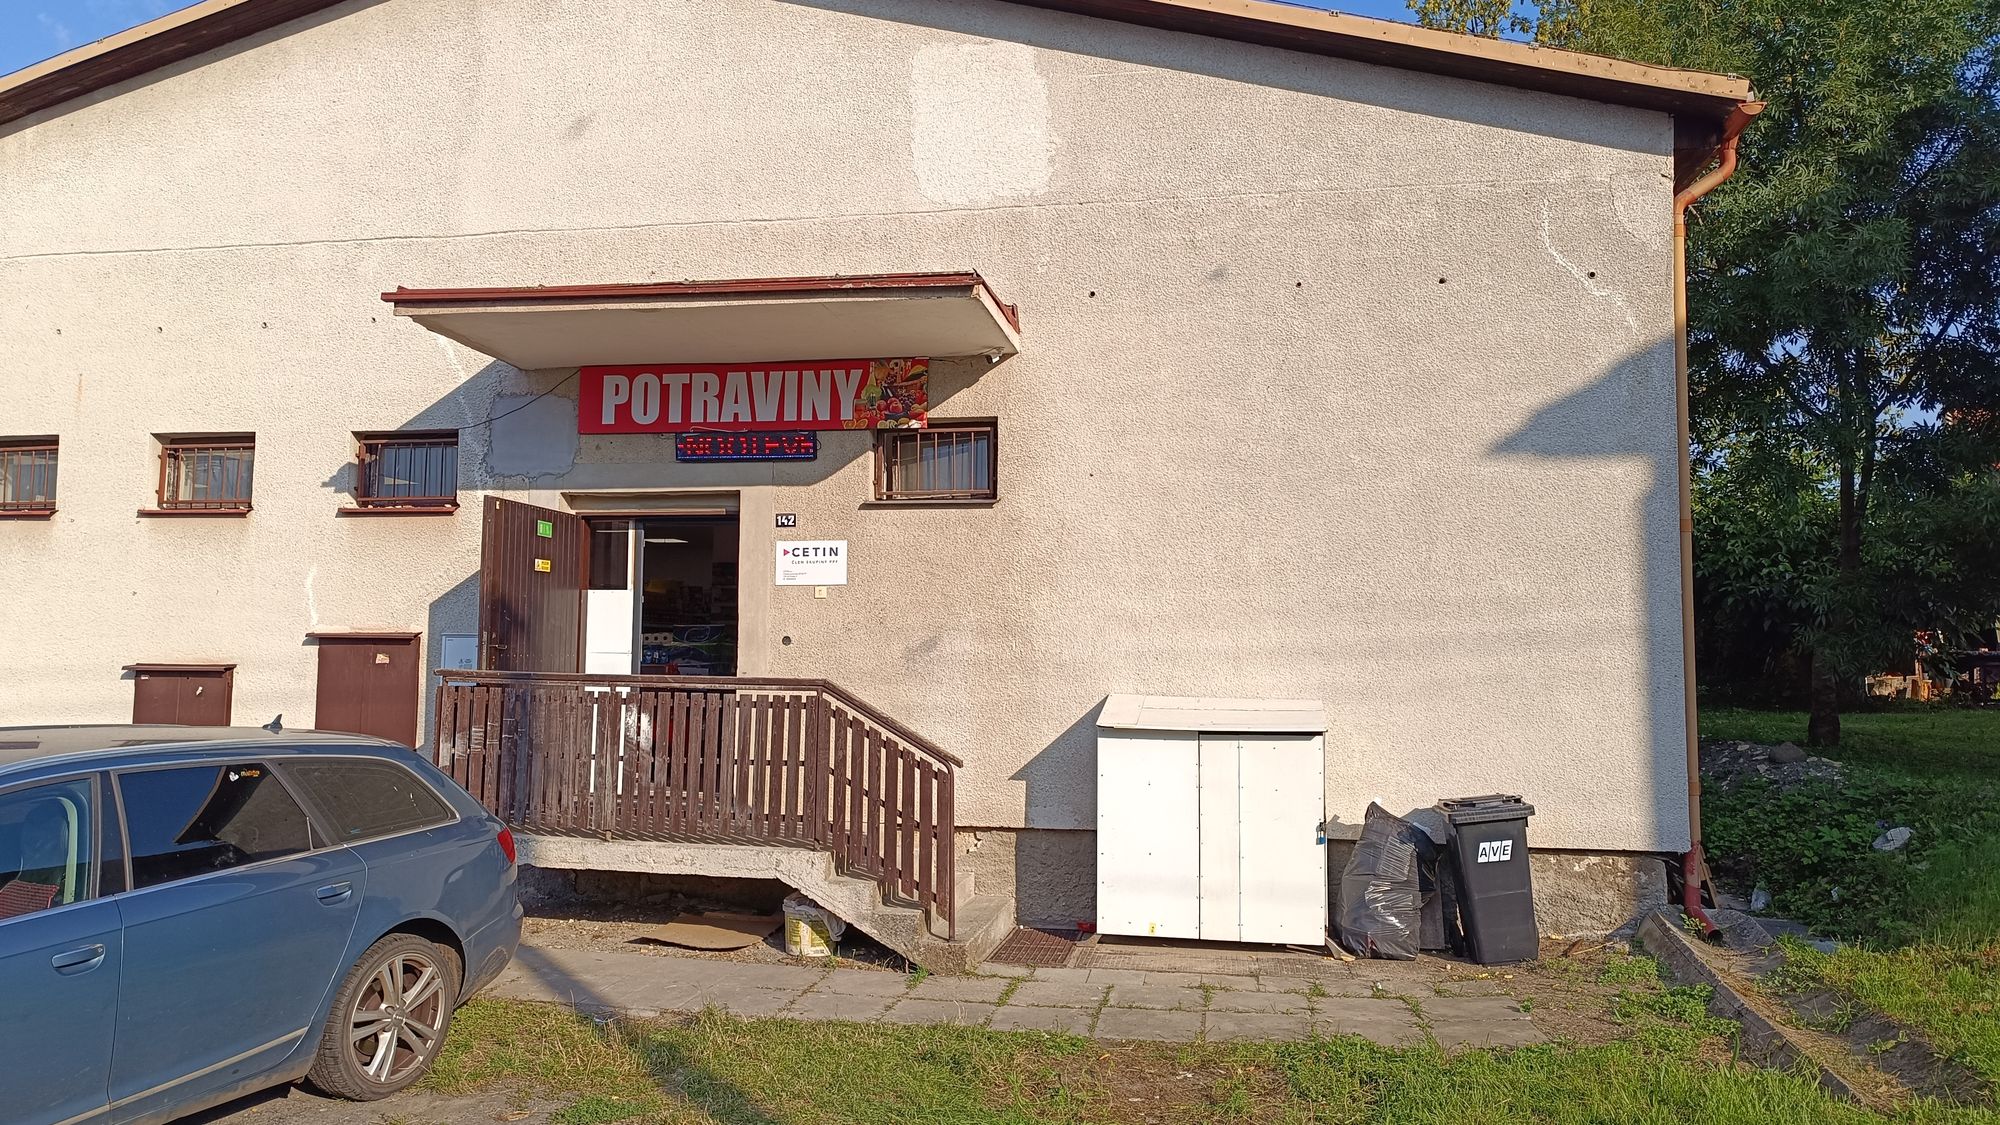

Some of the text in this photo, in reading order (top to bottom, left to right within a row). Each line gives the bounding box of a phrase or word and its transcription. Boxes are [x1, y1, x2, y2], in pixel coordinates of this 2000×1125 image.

[601, 369, 863, 425] POTRAVINY
[777, 515, 795, 526] 142
[792, 547, 838, 557] CETIN
[1480, 845, 1510, 857] AVE
